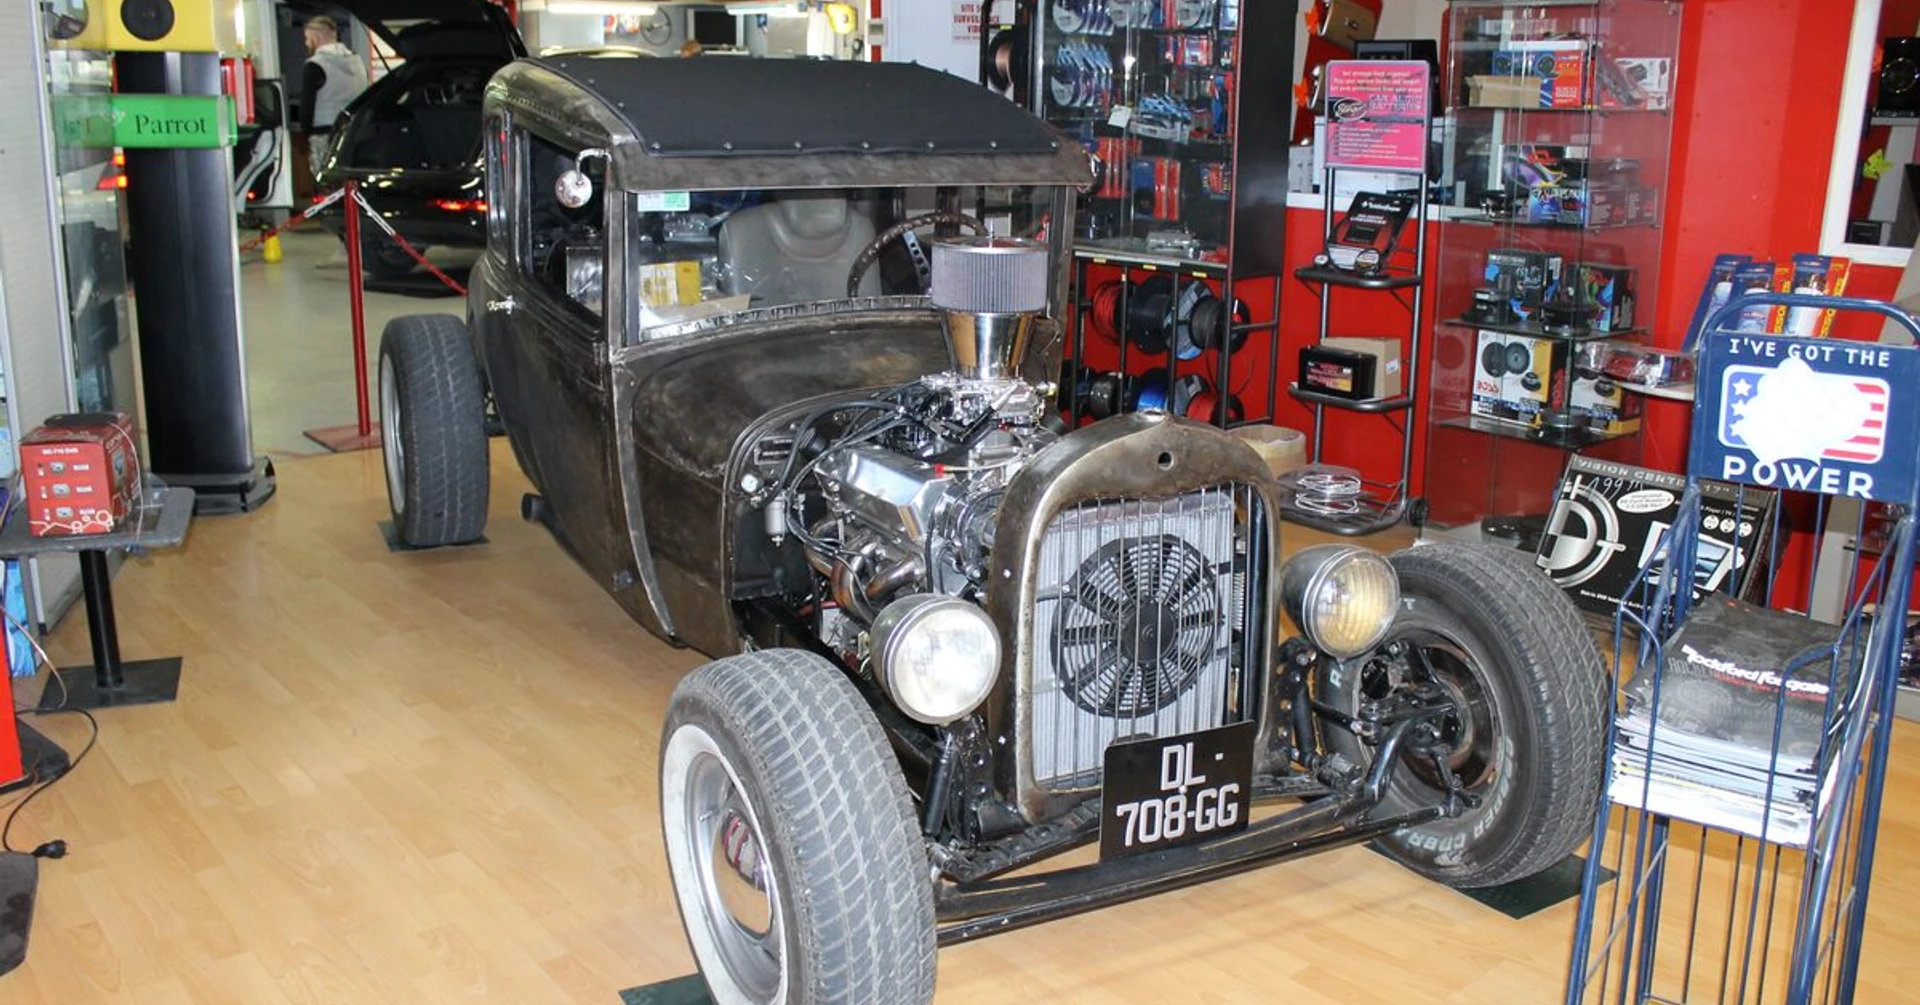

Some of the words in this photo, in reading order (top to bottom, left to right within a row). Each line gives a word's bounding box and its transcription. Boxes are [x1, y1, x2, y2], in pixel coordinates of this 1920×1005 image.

[134, 113, 206, 135] Parrot
[1729, 337, 1776, 357] I'VE
[1787, 343, 1835, 362] GOT
[1844, 348, 1890, 367] THE
[1579, 460, 1629, 476] VISION
[1634, 470, 1687, 488] CENTE
[1722, 455, 1874, 499] POWER
[1160, 742, 1206, 791] DL
[1116, 783, 1239, 847] 708-GG
